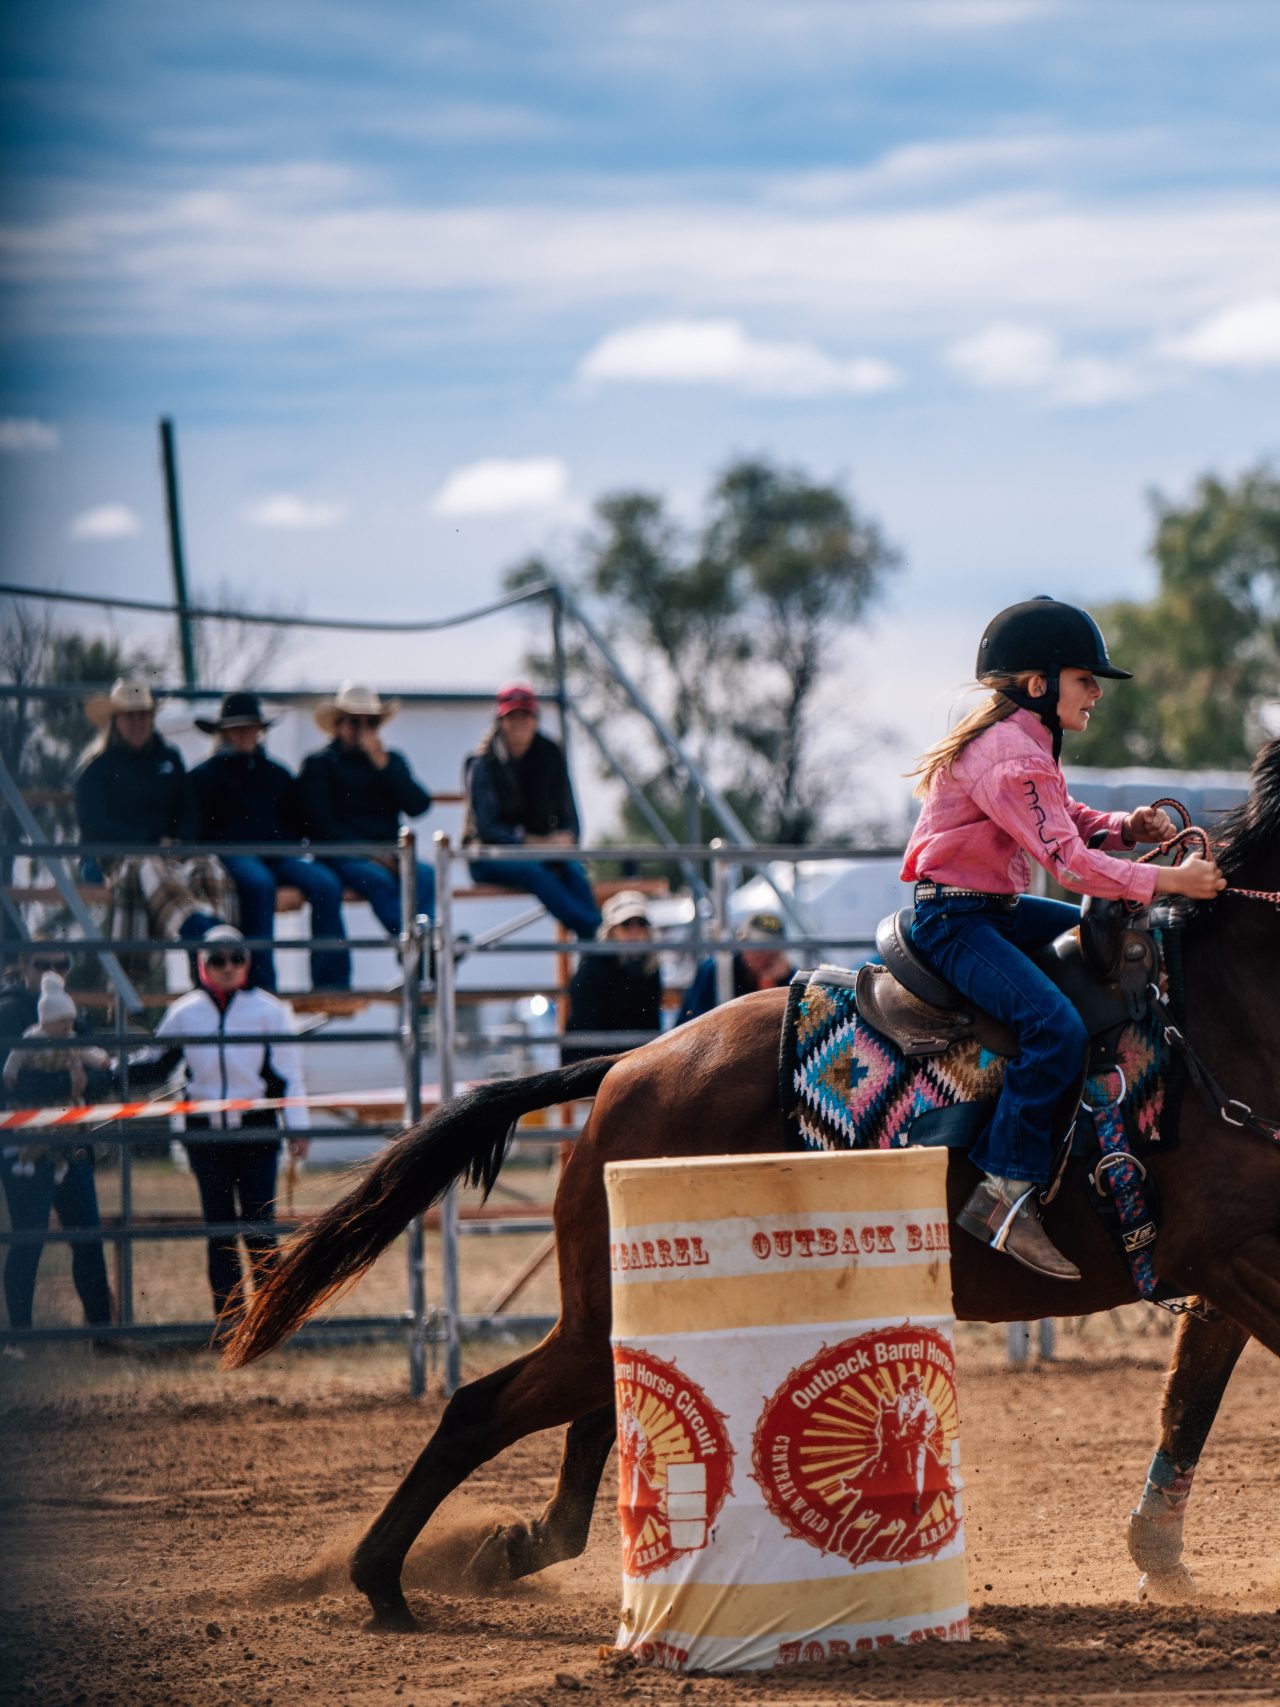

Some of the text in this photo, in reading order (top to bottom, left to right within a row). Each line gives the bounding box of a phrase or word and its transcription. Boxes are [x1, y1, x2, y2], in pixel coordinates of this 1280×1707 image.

[620, 1237, 710, 1270] BARREL
[752, 1225, 896, 1259] OUTBACK
[791, 1349, 872, 1410] Outback
[874, 1340, 925, 1365] Barrel
[637, 1363, 675, 1399] Horse
[675, 1390, 718, 1456] Circuit
[772, 1435, 797, 1501] CENTRAL
